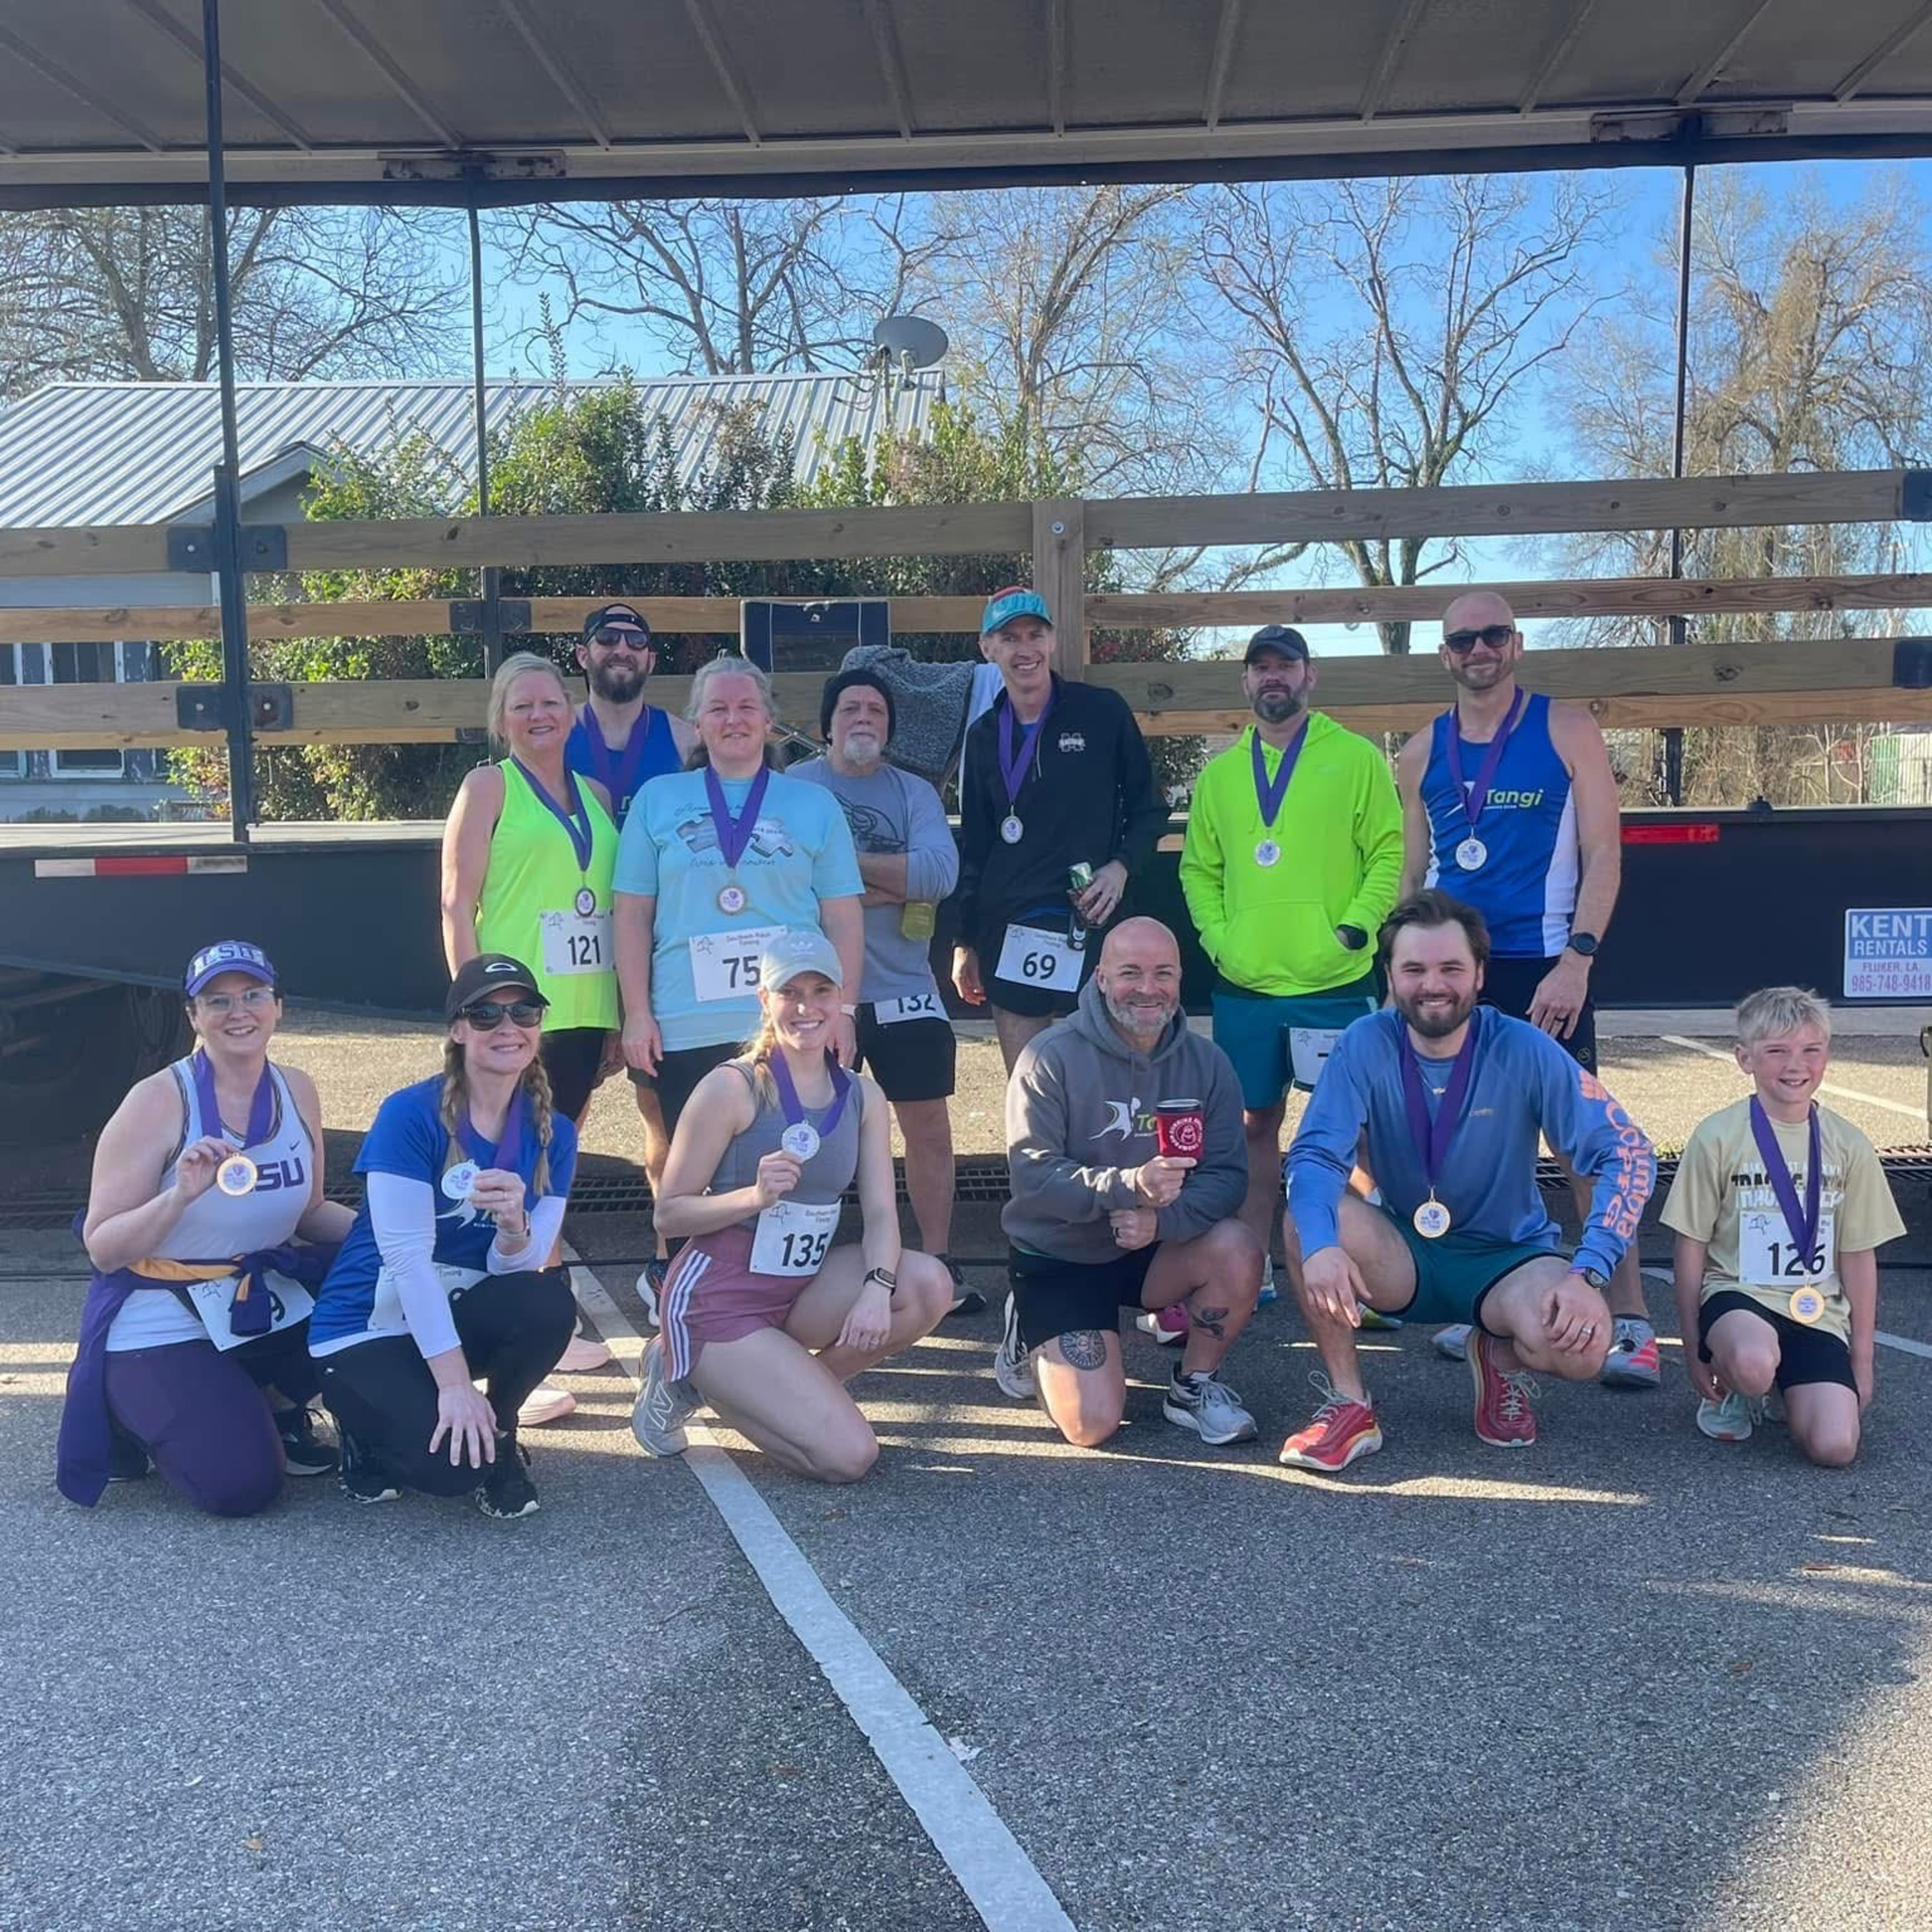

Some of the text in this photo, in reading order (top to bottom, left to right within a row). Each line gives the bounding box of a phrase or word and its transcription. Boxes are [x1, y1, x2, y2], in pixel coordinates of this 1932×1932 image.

[1486, 789, 1544, 808] Tangi
[1851, 914, 1932, 938] KENT
[567, 935, 600, 965] 121
[1854, 940, 1927, 956] RENTALS
[722, 955, 761, 988] 75
[1023, 952, 1056, 980] 69
[1852, 974, 1931, 992] 985-748-9418
[251, 1157, 305, 1192] SU
[782, 1233, 829, 1267] 135
[1767, 1242, 1826, 1276] 126
